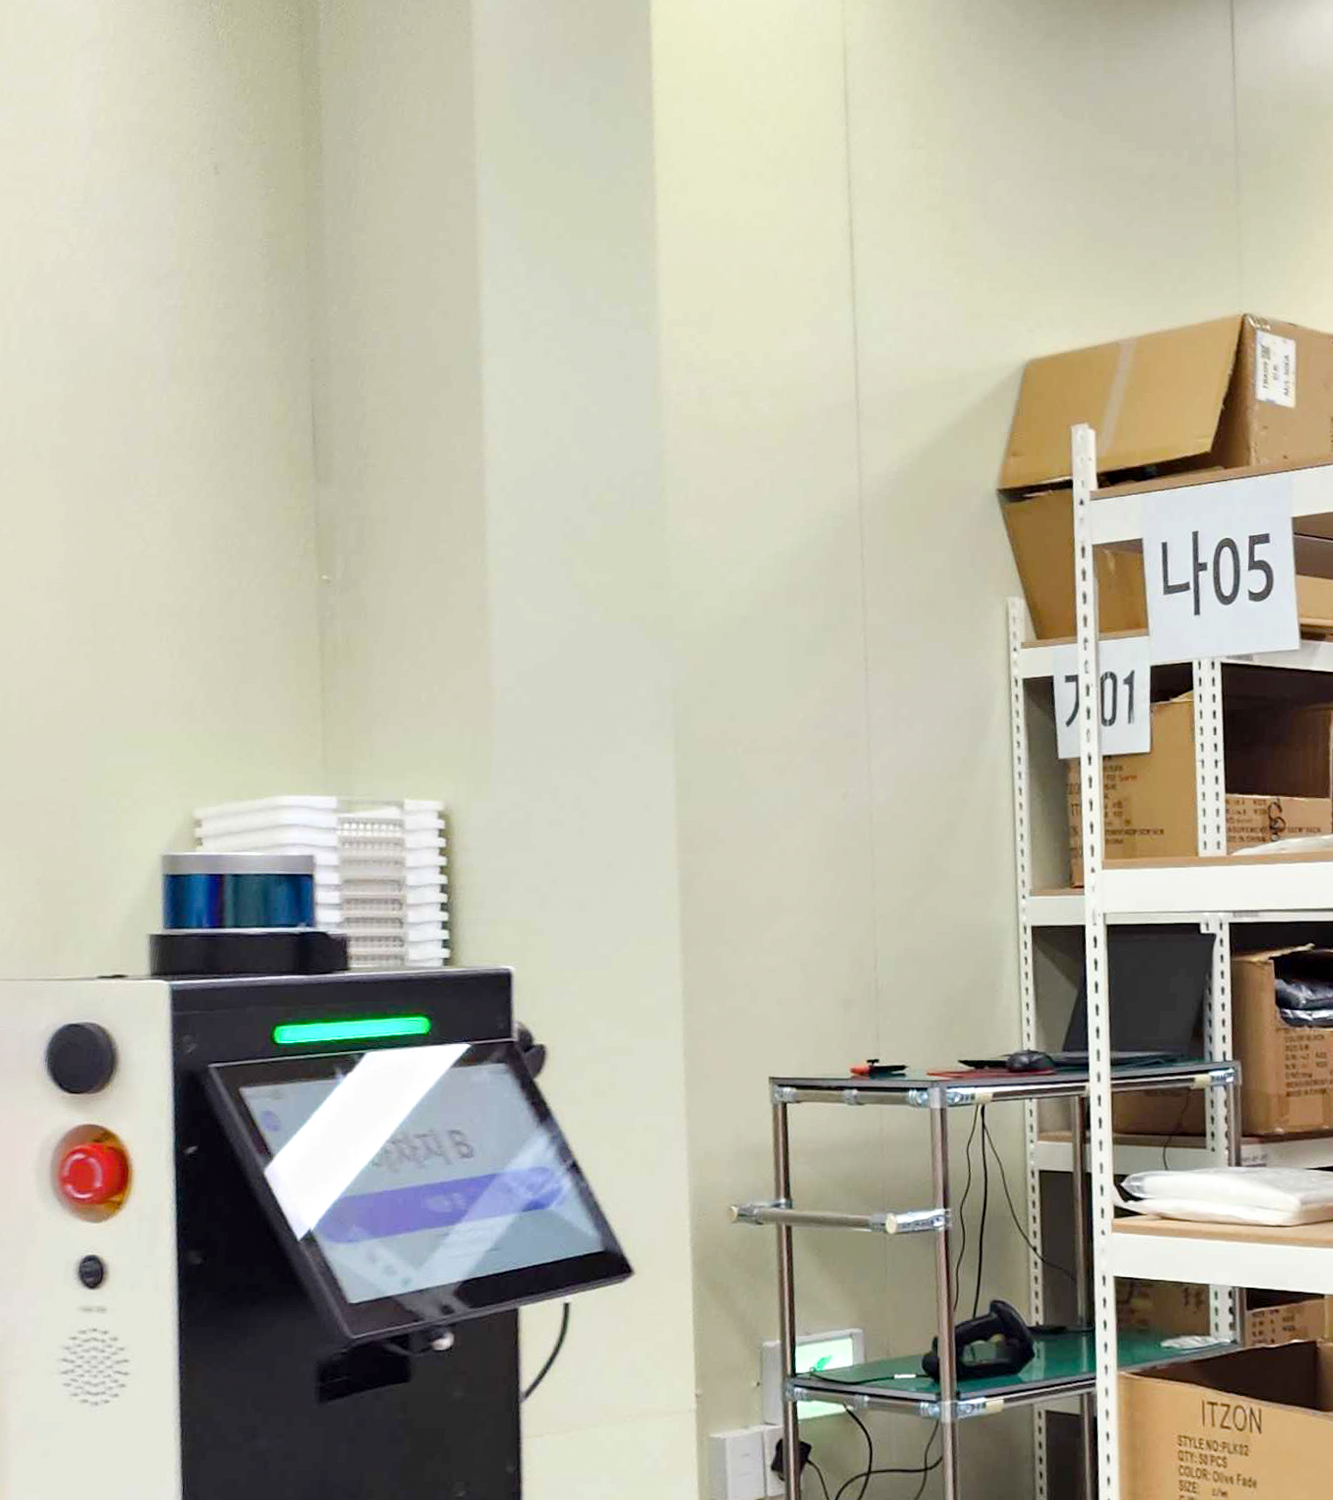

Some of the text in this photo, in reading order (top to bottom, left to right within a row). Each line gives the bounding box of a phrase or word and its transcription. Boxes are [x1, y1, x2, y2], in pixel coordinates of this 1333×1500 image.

[1161, 530, 1275, 616] 나05
[1201, 1400, 1262, 1434] ITZON
[1178, 1434, 1204, 1449] STYLE
[1178, 1450, 1228, 1469] QTY: 50 PCS
[1178, 1465, 1257, 1489] COLOR: Olive Fade
